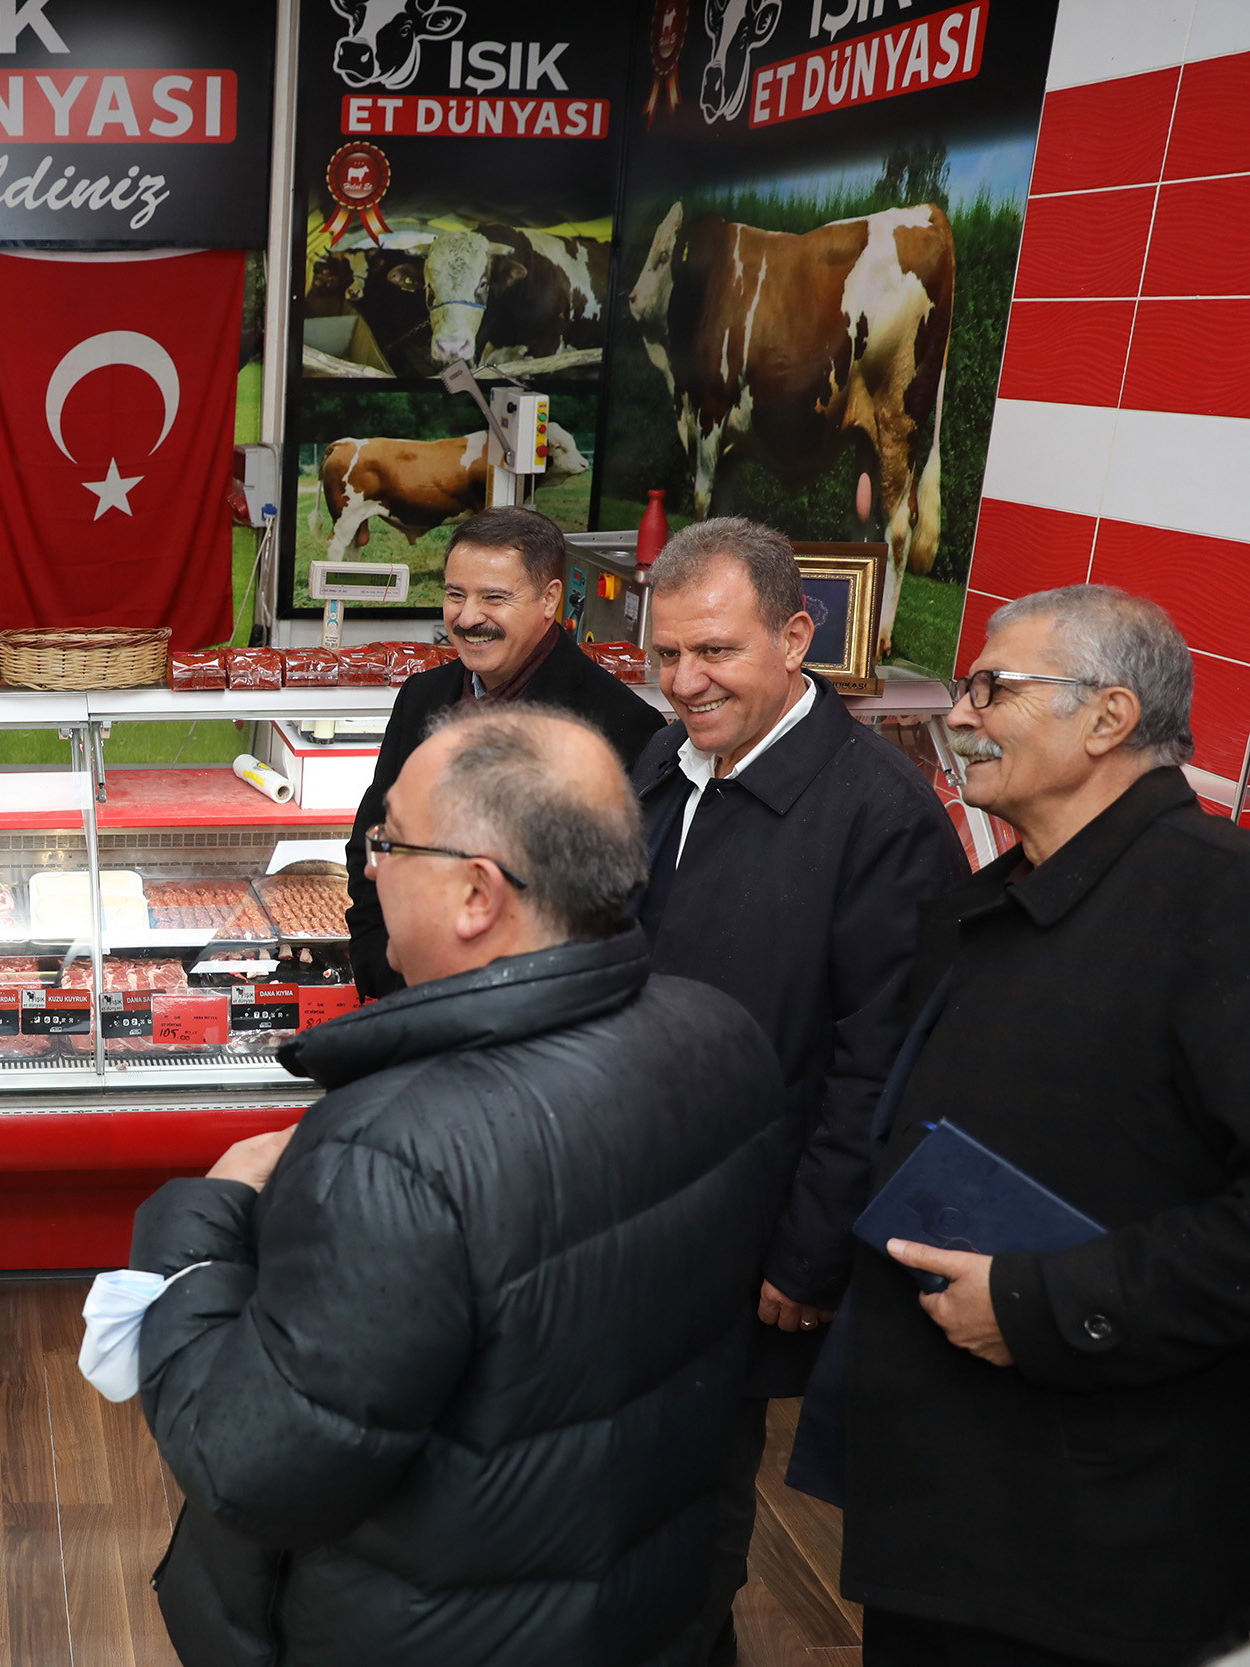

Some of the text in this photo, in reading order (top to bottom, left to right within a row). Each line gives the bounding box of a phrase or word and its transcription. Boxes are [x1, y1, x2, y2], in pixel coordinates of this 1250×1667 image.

[449, 40, 570, 96] IŞIK
[753, 6, 981, 123] ET DÜNYASI
[348, 98, 603, 136] ET DÜNYASI
[126, 996, 141, 1004] DANA
[276, 989, 294, 997] KIYMA
